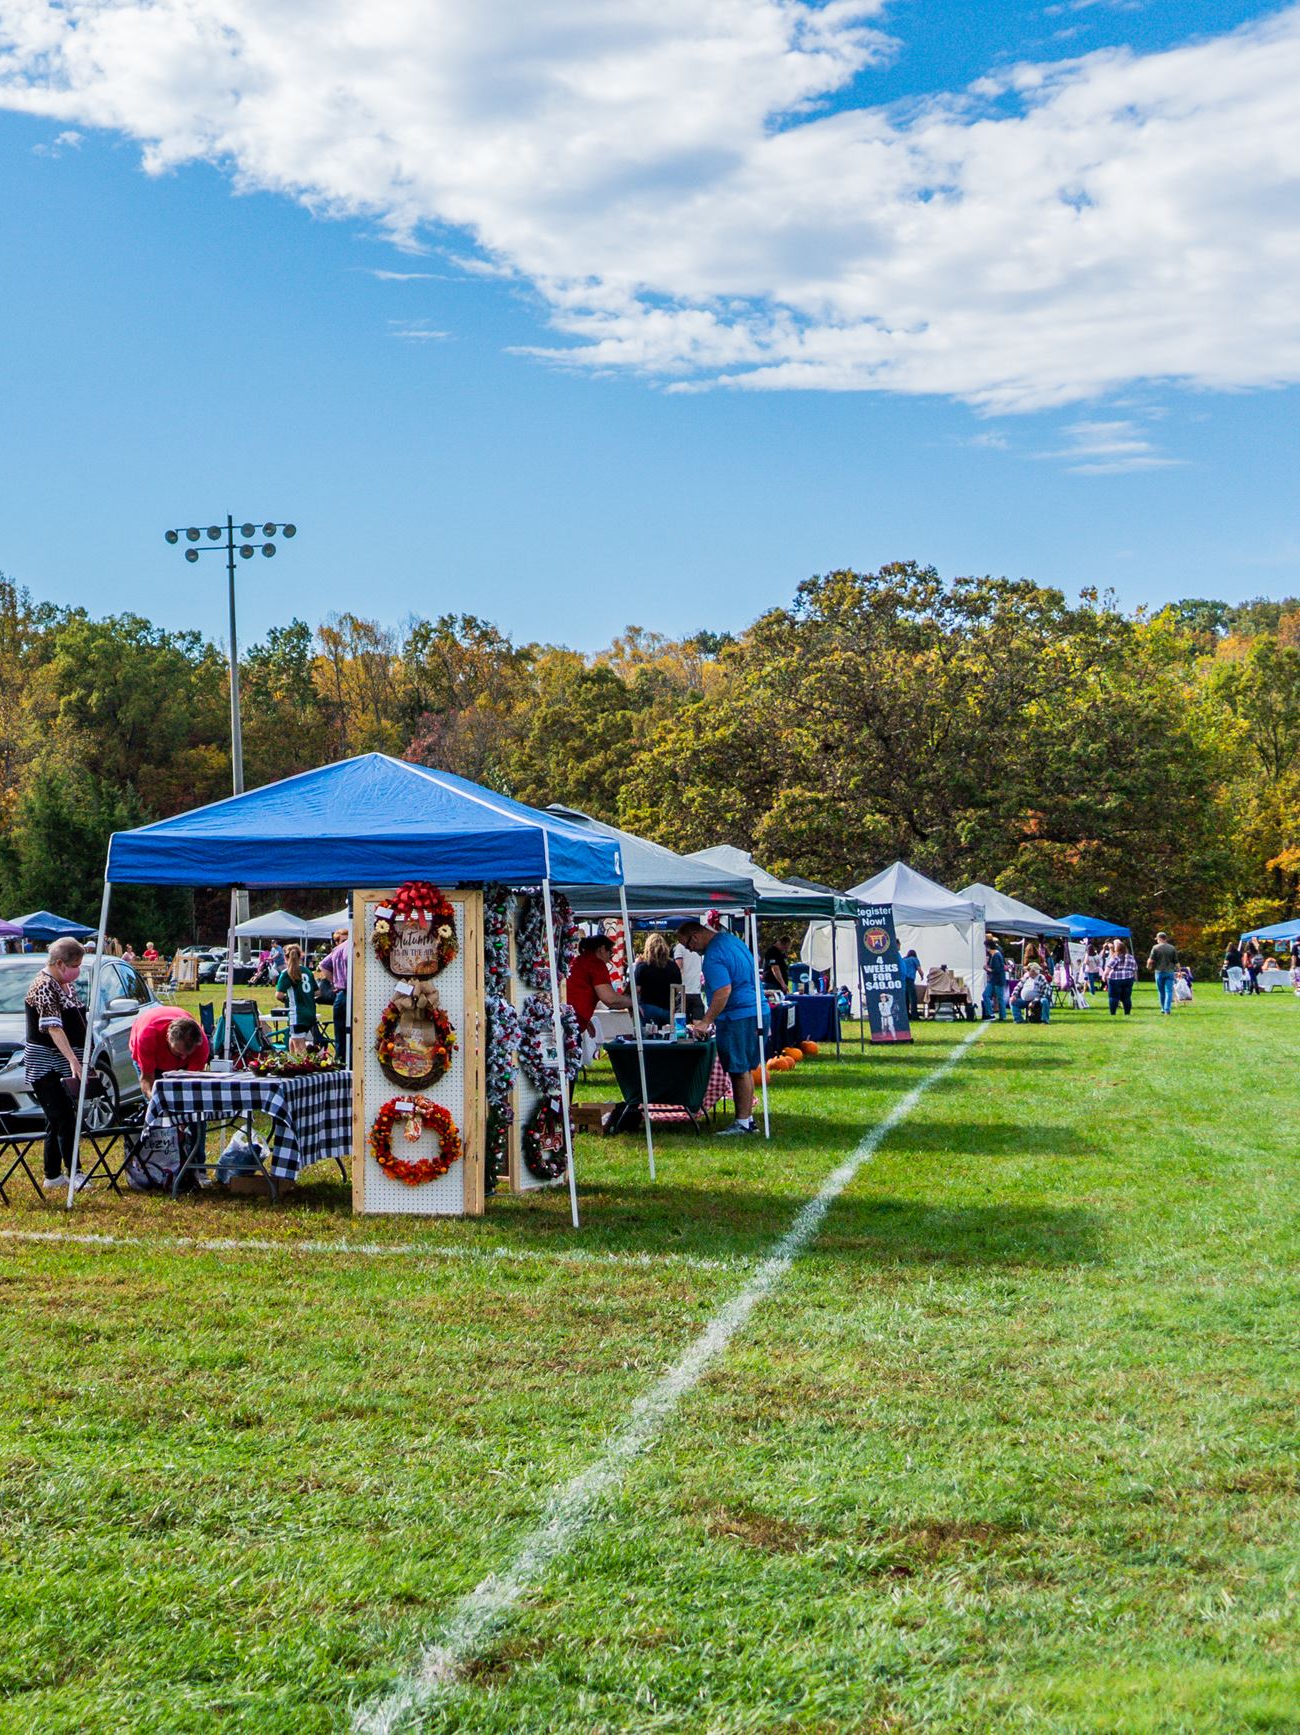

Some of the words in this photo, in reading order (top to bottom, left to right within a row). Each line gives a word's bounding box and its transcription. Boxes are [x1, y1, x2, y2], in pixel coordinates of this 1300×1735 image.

[862, 917, 886, 926] Now!
[876, 956, 883, 964] 4
[863, 964, 898, 973] WEEKS
[873, 973, 892, 981] FOR
[301, 973, 311, 993] 8
[865, 980, 902, 990] $49.00
